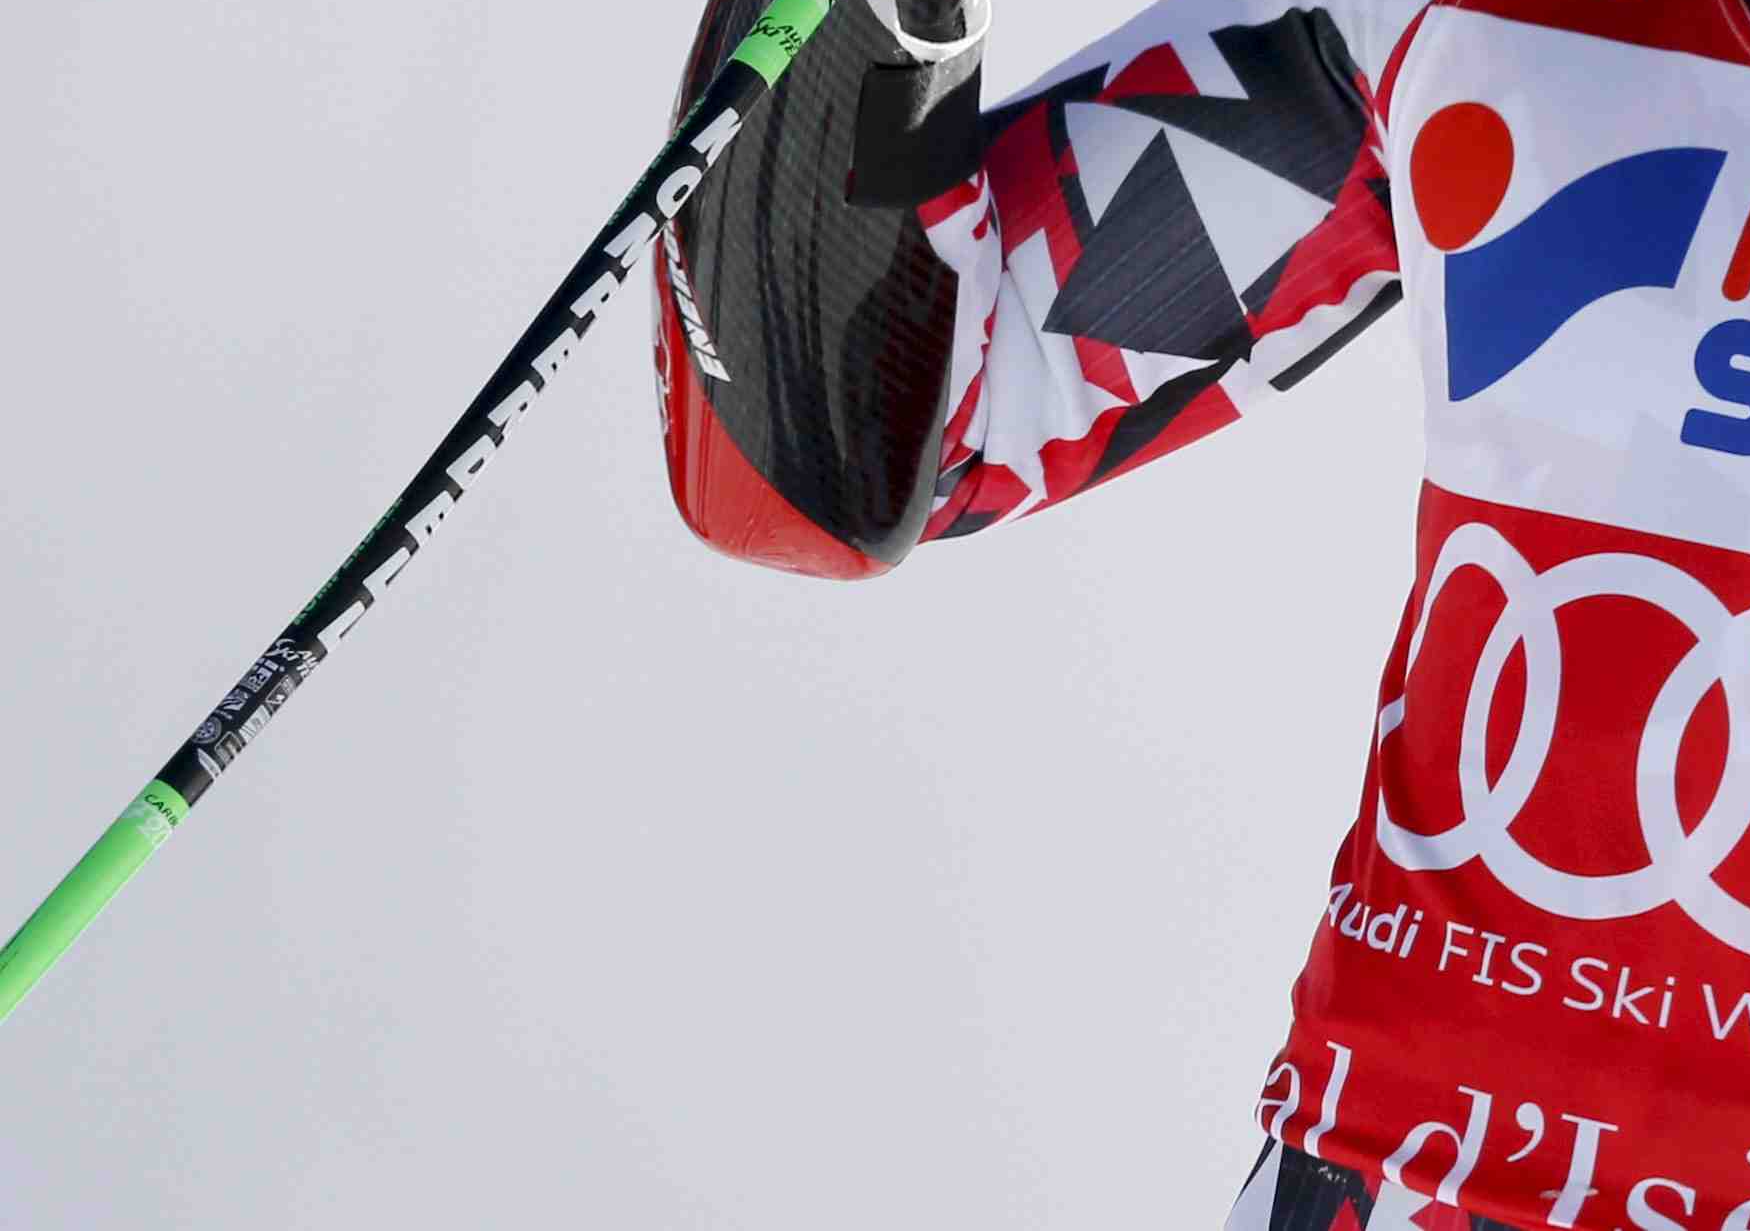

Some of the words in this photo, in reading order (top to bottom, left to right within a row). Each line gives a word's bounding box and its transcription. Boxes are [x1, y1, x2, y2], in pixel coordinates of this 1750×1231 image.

[1328, 882, 1424, 959] Audi
[1438, 920, 1549, 996] FIS
[1562, 956, 1677, 1029] Ski
[1254, 1040, 1352, 1158] al
